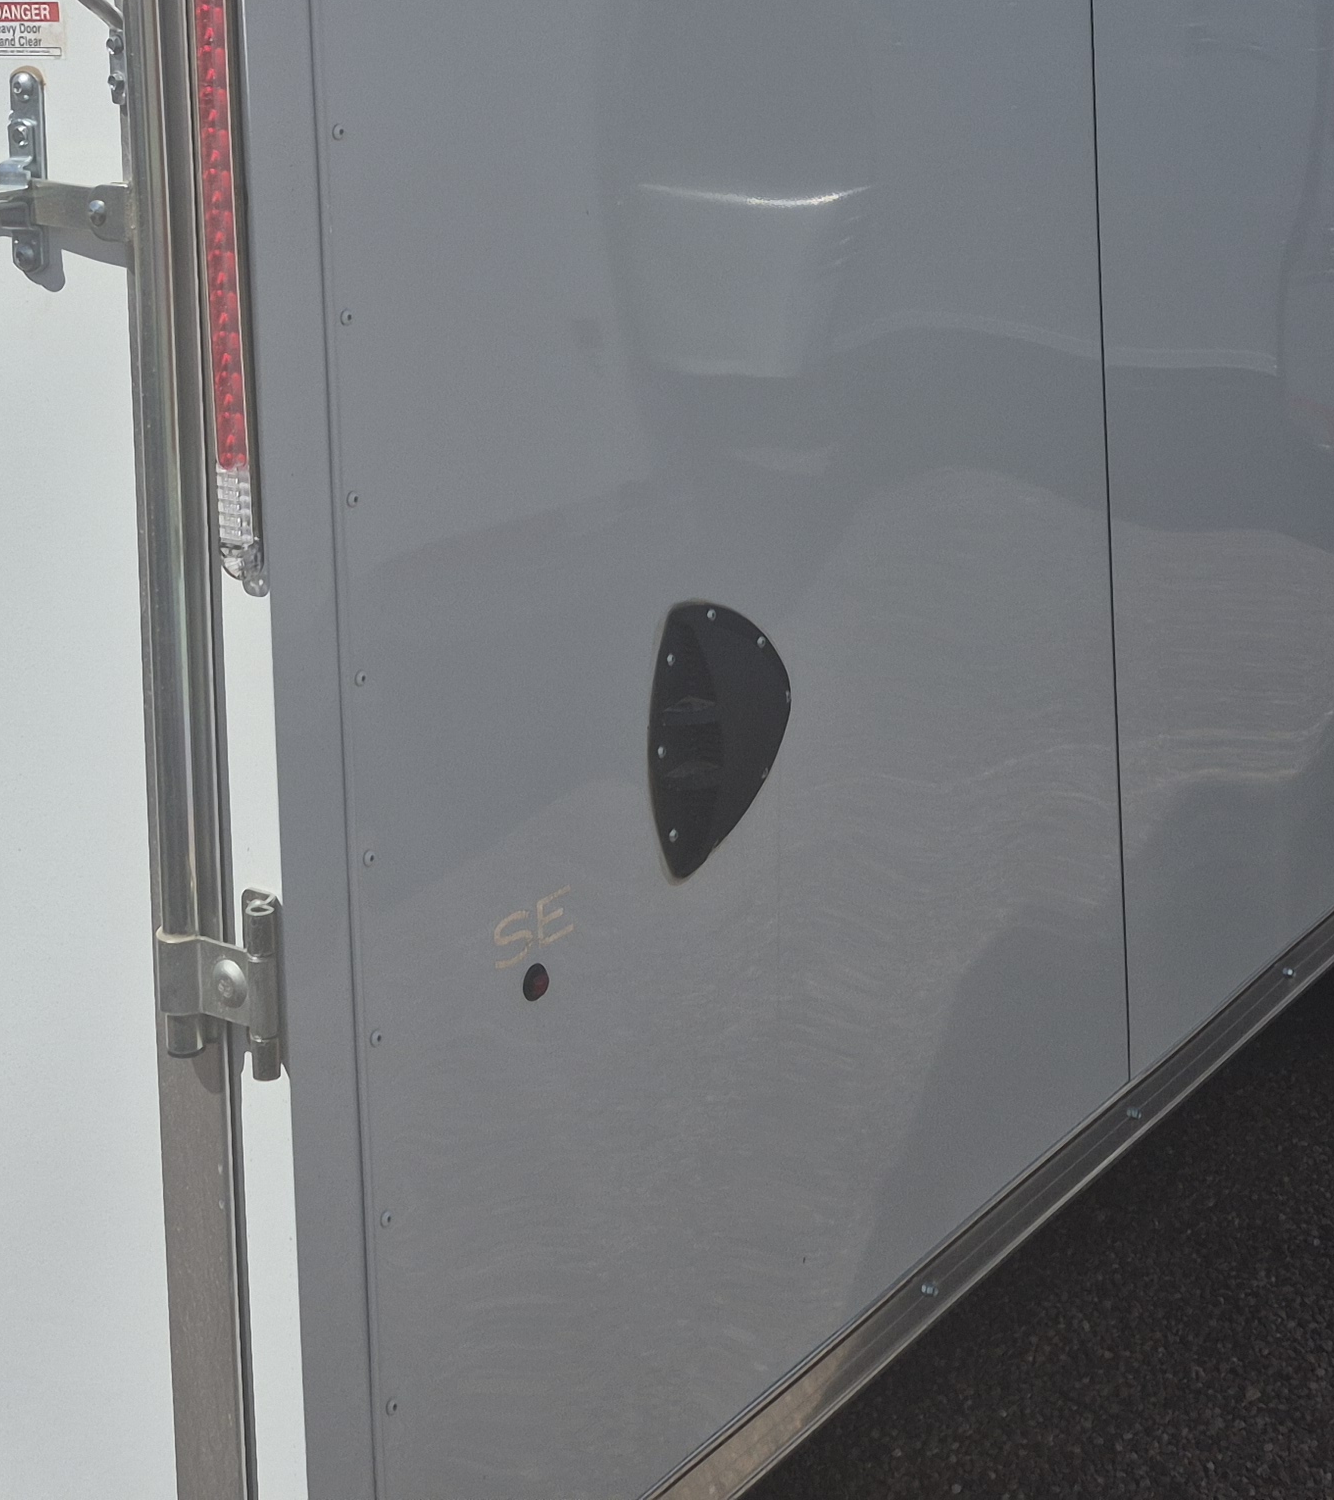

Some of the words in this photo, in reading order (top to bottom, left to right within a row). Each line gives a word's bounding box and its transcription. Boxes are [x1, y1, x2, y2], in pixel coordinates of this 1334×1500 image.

[19, 23, 42, 33] Door
[18, 35, 42, 46] Clear
[493, 884, 575, 969] SE
